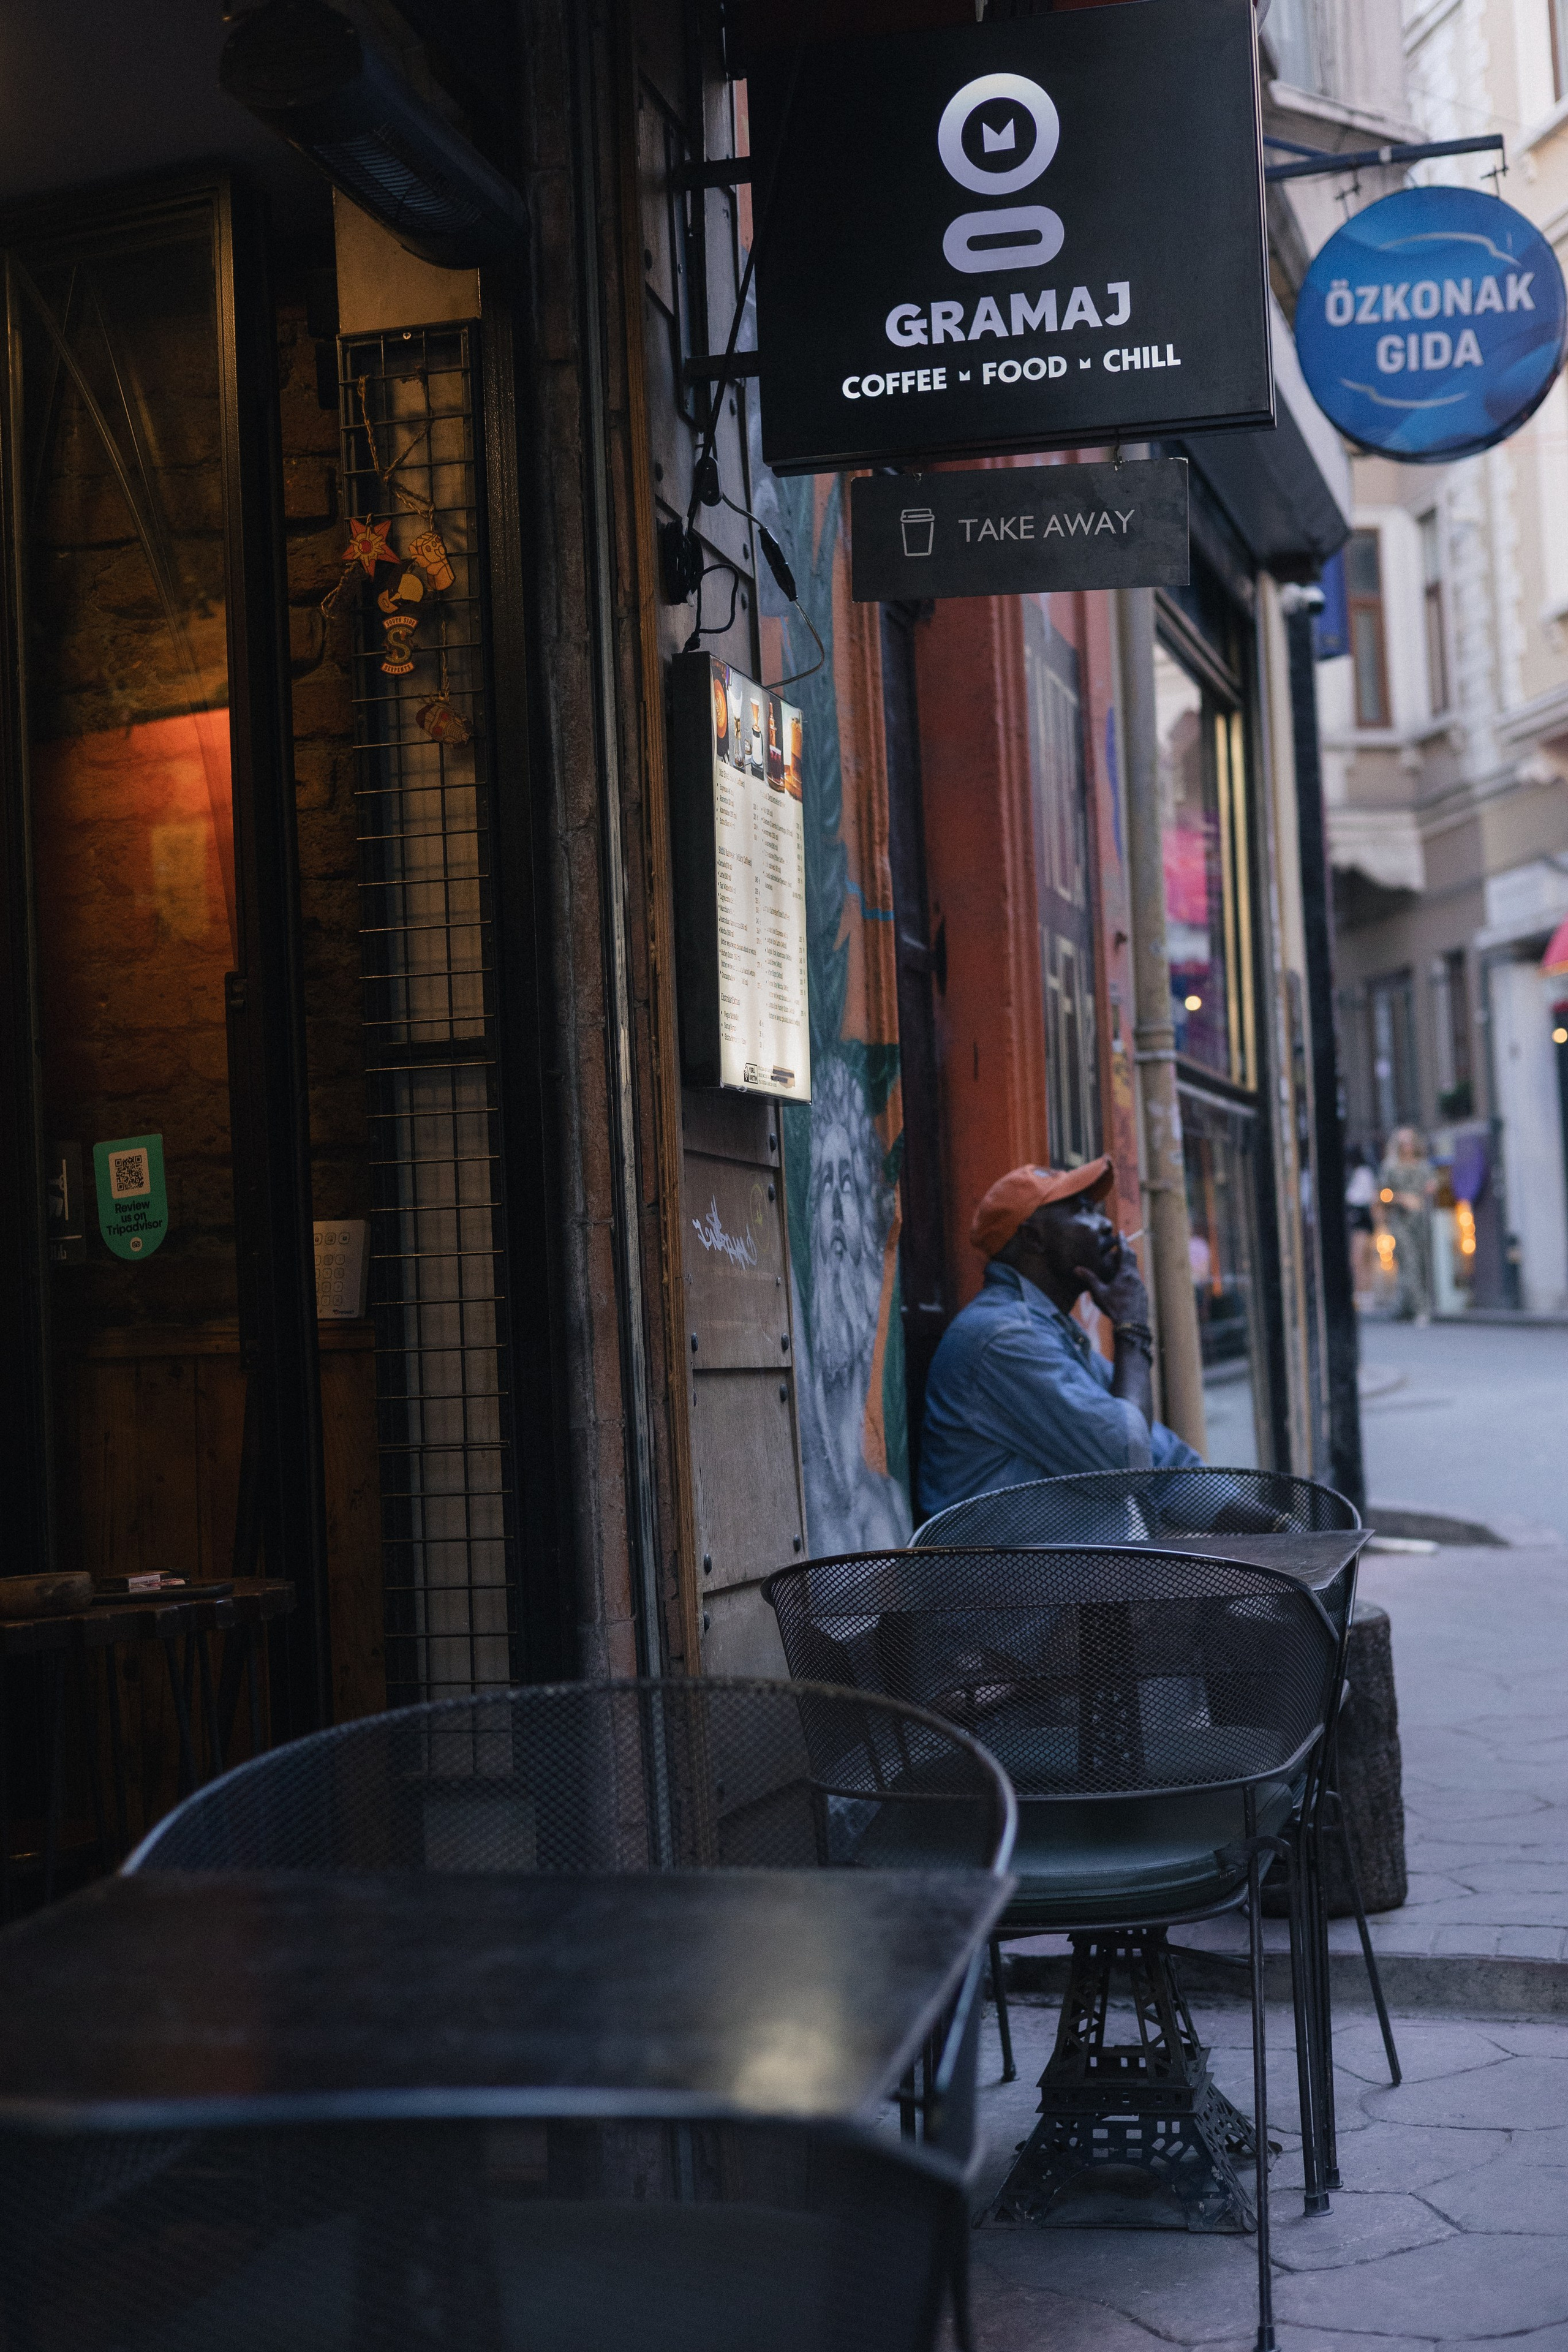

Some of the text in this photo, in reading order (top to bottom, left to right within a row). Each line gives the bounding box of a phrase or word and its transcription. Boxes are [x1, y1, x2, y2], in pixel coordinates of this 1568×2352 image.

[1324, 271, 1536, 327] ÖZKONAK
[886, 281, 1132, 347] GRAMAJ
[1376, 329, 1485, 374] GIDA
[842, 344, 1182, 399] COFFEE FOOD CHILL
[958, 509, 1136, 543] TAKE AWAY
[386, 617, 415, 627] SOUTH SIDE
[384, 665, 411, 673] SERPENTS
[115, 1200, 149, 1214] Review
[121, 1212, 146, 1223] us on
[107, 1219, 163, 1236] Tripadvisor
